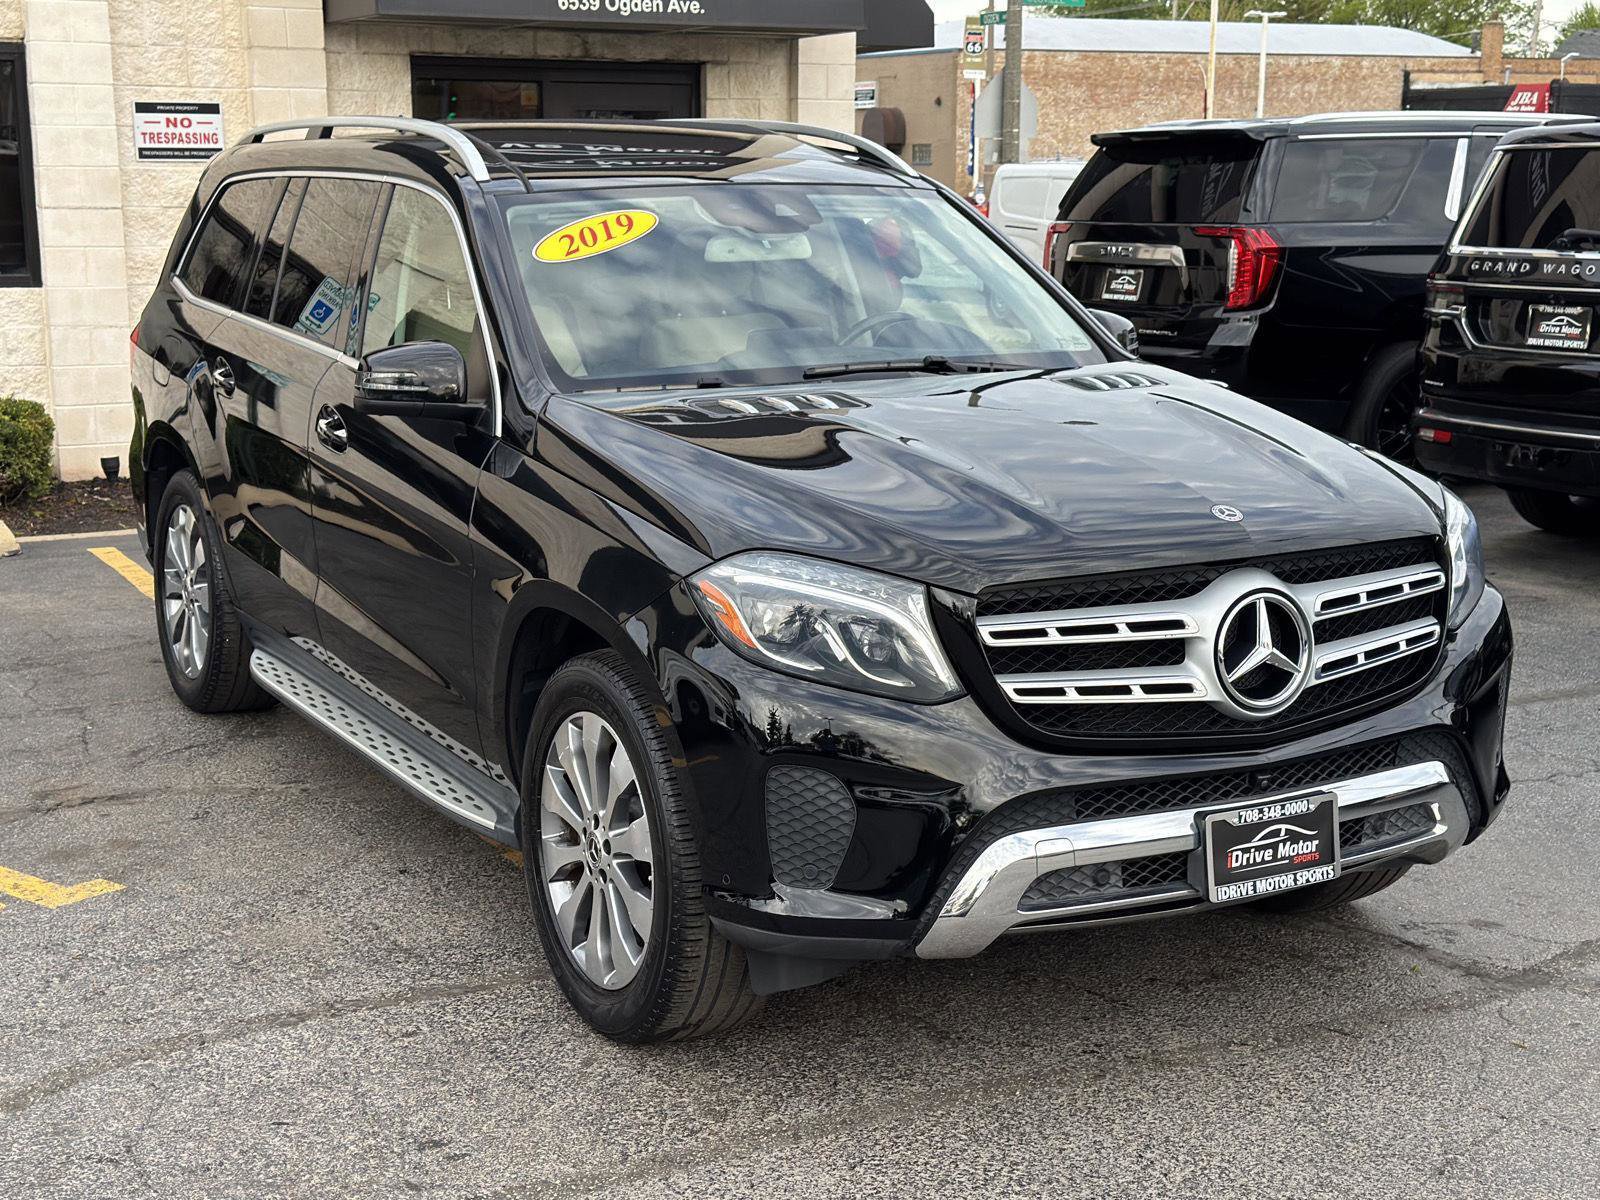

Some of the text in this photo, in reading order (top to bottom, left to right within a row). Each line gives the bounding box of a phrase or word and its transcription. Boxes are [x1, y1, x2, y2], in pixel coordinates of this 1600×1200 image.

[557, 0, 705, 16] 6539 Ogden Ave.
[966, 42, 983, 53] 66
[1510, 91, 1539, 106] JBA
[165, 117, 193, 129] NO
[141, 132, 219, 145] TRESPASSING
[558, 213, 634, 257] 2019
[1470, 260, 1531, 273] GRAND
[1561, 325, 1583, 335] Motor
[1544, 338, 1564, 347] MOTOR
[1563, 340, 1586, 349] SPORTS
[1239, 800, 1309, 823] 708-348-0000
[1227, 839, 1320, 869] iDrive Motor
[1293, 852, 1320, 864] SPORTS
[1255, 873, 1295, 894] MOTOR
[1296, 865, 1335, 886] SPORTS
